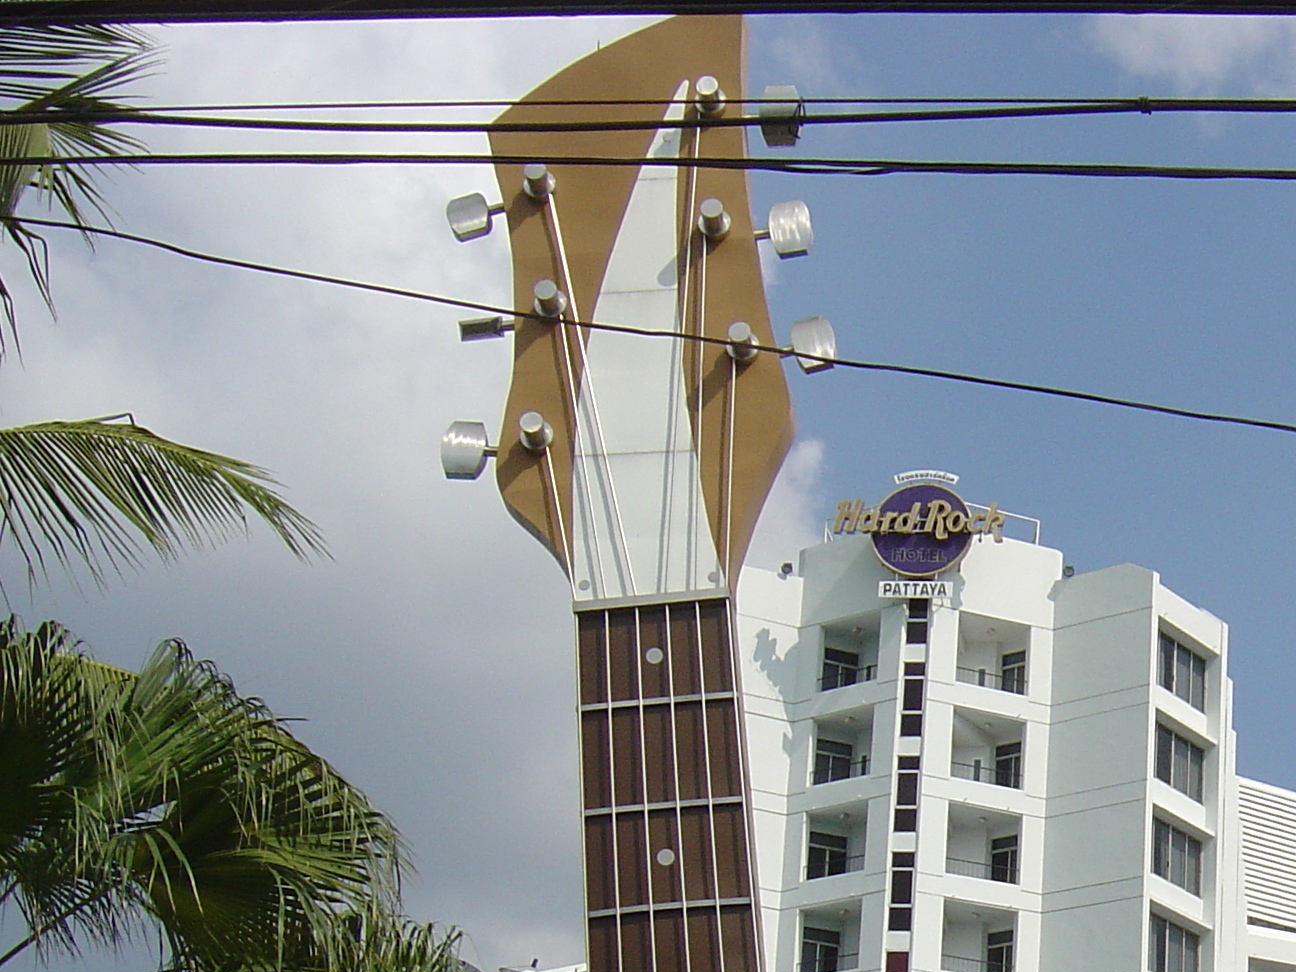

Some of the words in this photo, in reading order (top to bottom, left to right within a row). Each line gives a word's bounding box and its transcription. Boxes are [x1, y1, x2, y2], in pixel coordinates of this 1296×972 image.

[832, 498, 923, 535] Hard
[923, 500, 1005, 543] Rock
[891, 547, 948, 563] HOTEL
[883, 582, 947, 596] PATTAYA
